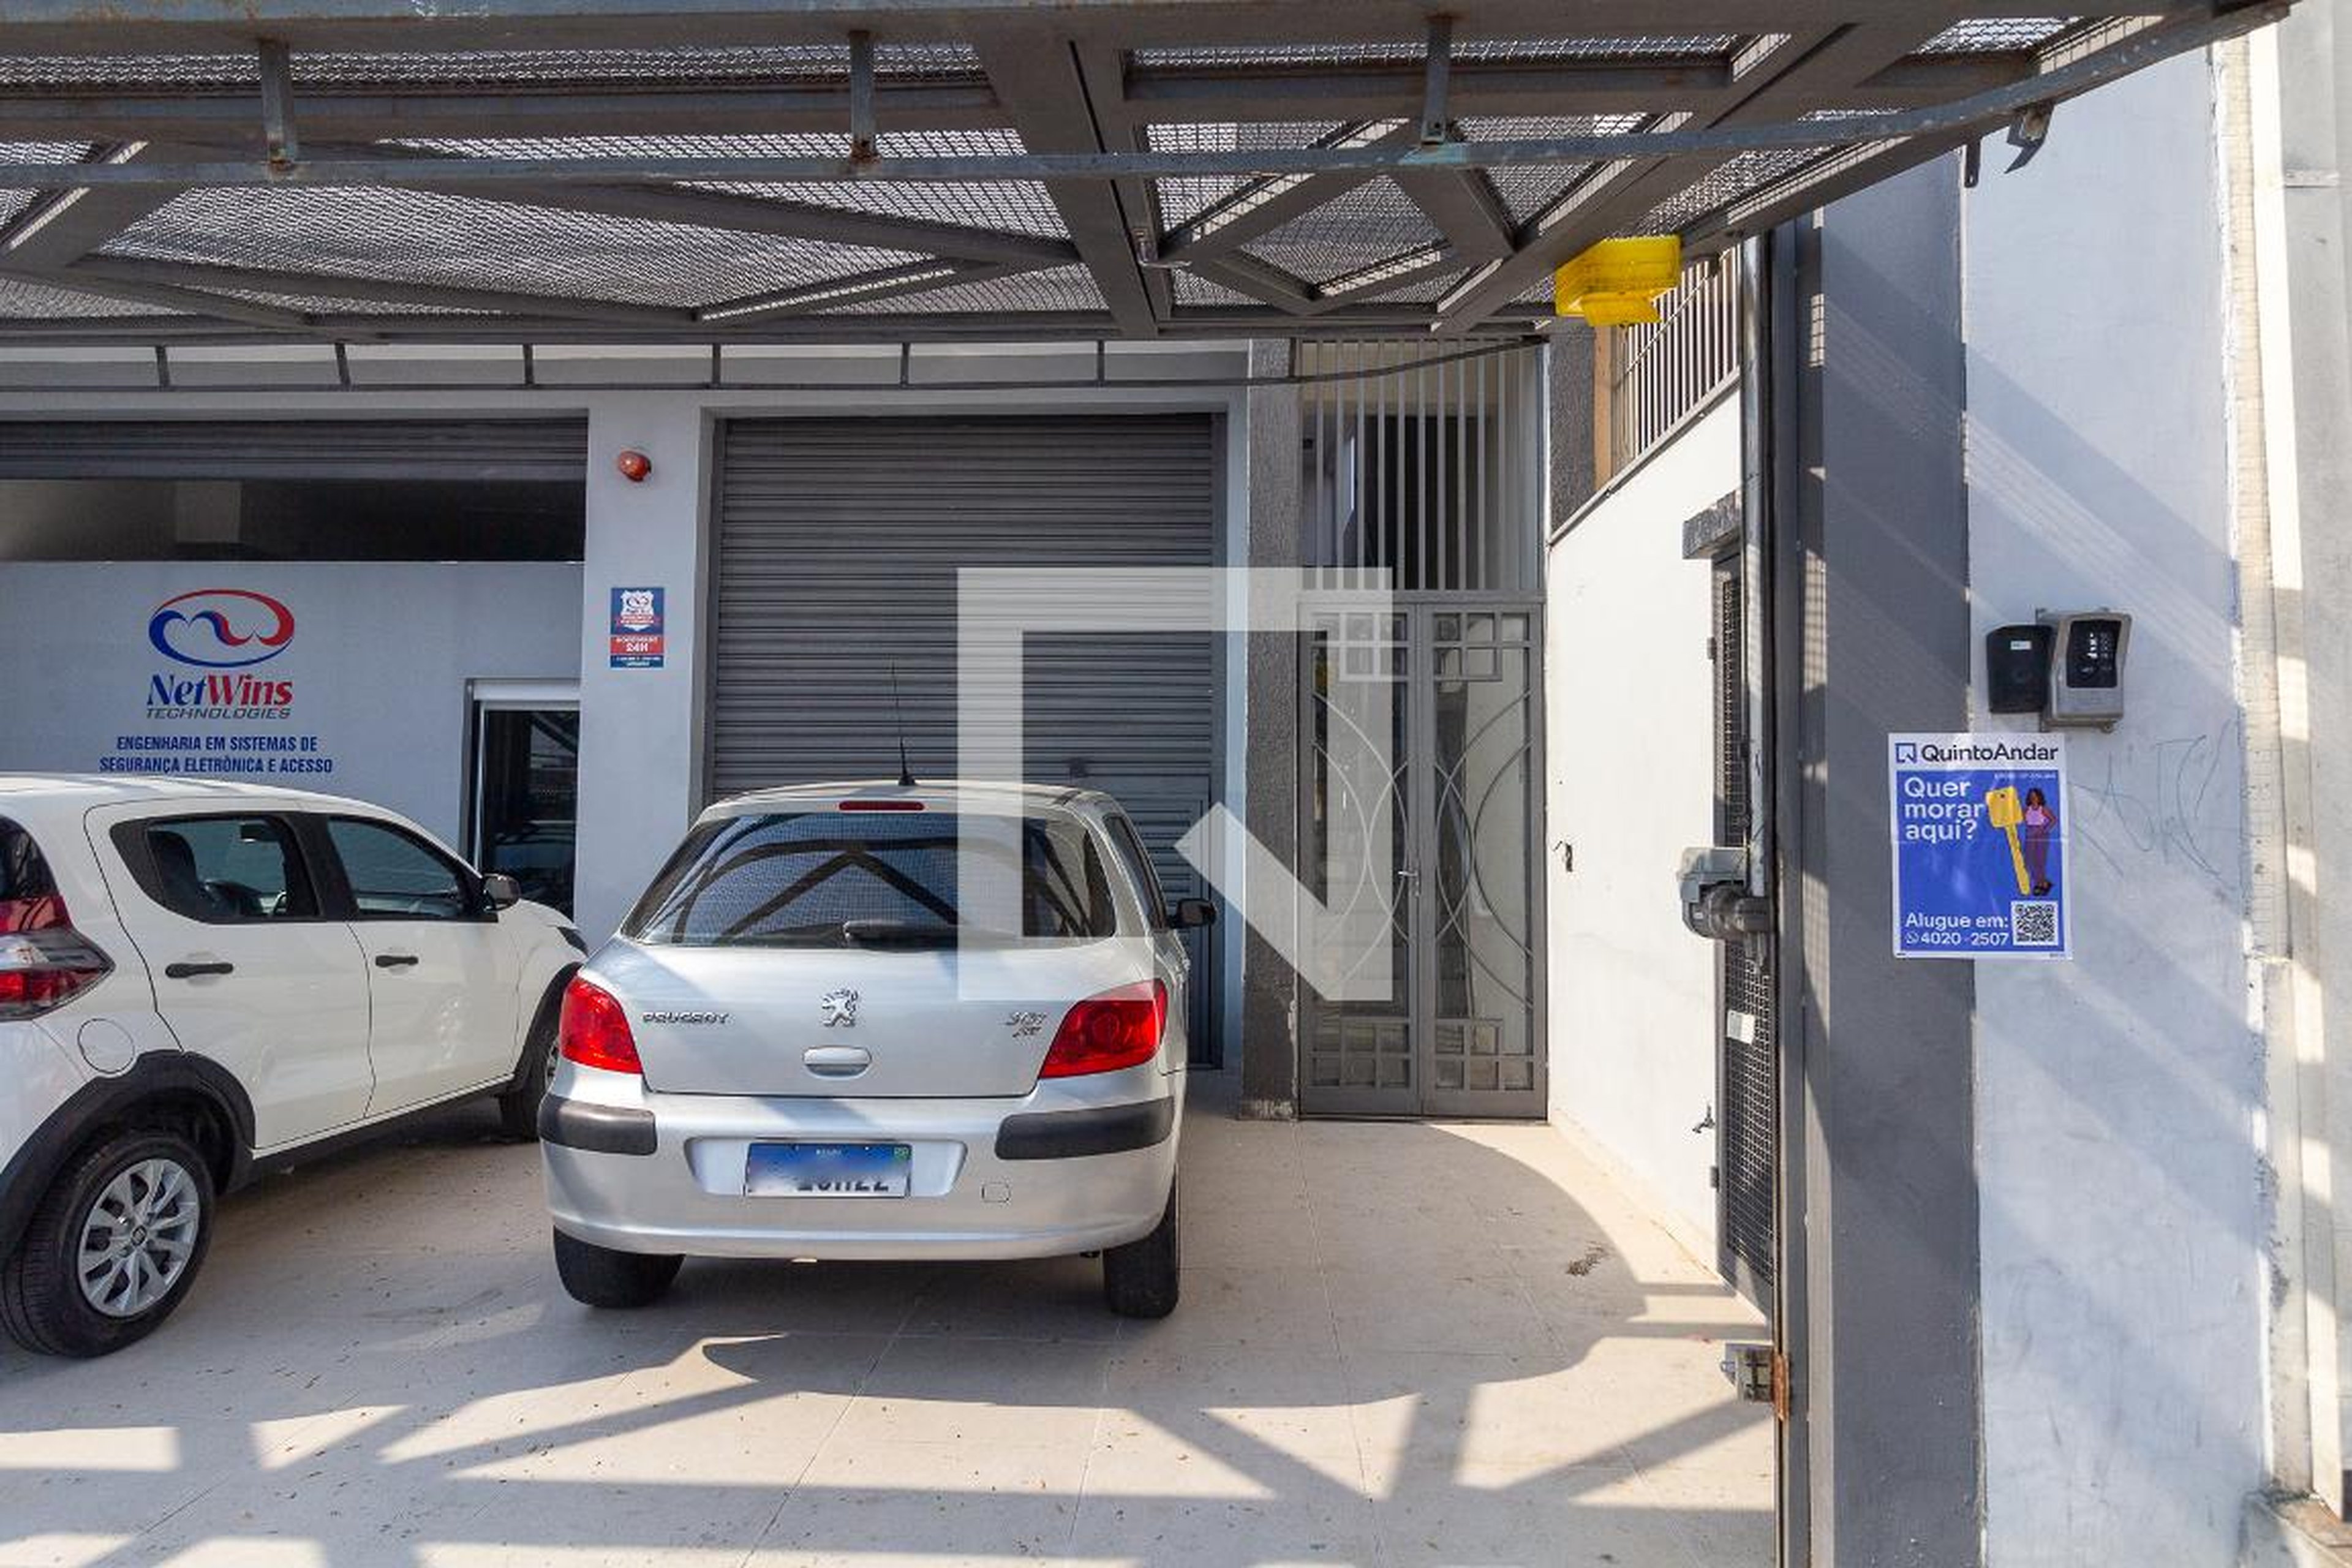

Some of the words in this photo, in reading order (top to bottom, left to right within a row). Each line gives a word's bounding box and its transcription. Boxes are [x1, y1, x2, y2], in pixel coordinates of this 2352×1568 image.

[147, 674, 293, 706] NetWins
[147, 708, 291, 719] TECHNOLOGIES
[117, 736, 202, 752] ENGENHARIA
[206, 736, 225, 752] EM
[230, 736, 296, 752] SISTEMAS
[301, 736, 317, 752] DE
[1921, 744, 2059, 762] QuintoAndar
[100, 758, 179, 774] SEGURANÇA
[184, 756, 264, 773] ELETRÔNICA
[268, 758, 276, 772] E
[279, 758, 333, 773] ACESSO
[1904, 777, 1970, 799] Quer
[1904, 803, 1985, 819] morar
[1905, 820, 1977, 844] aqui?
[1905, 913, 1971, 930] Alugue
